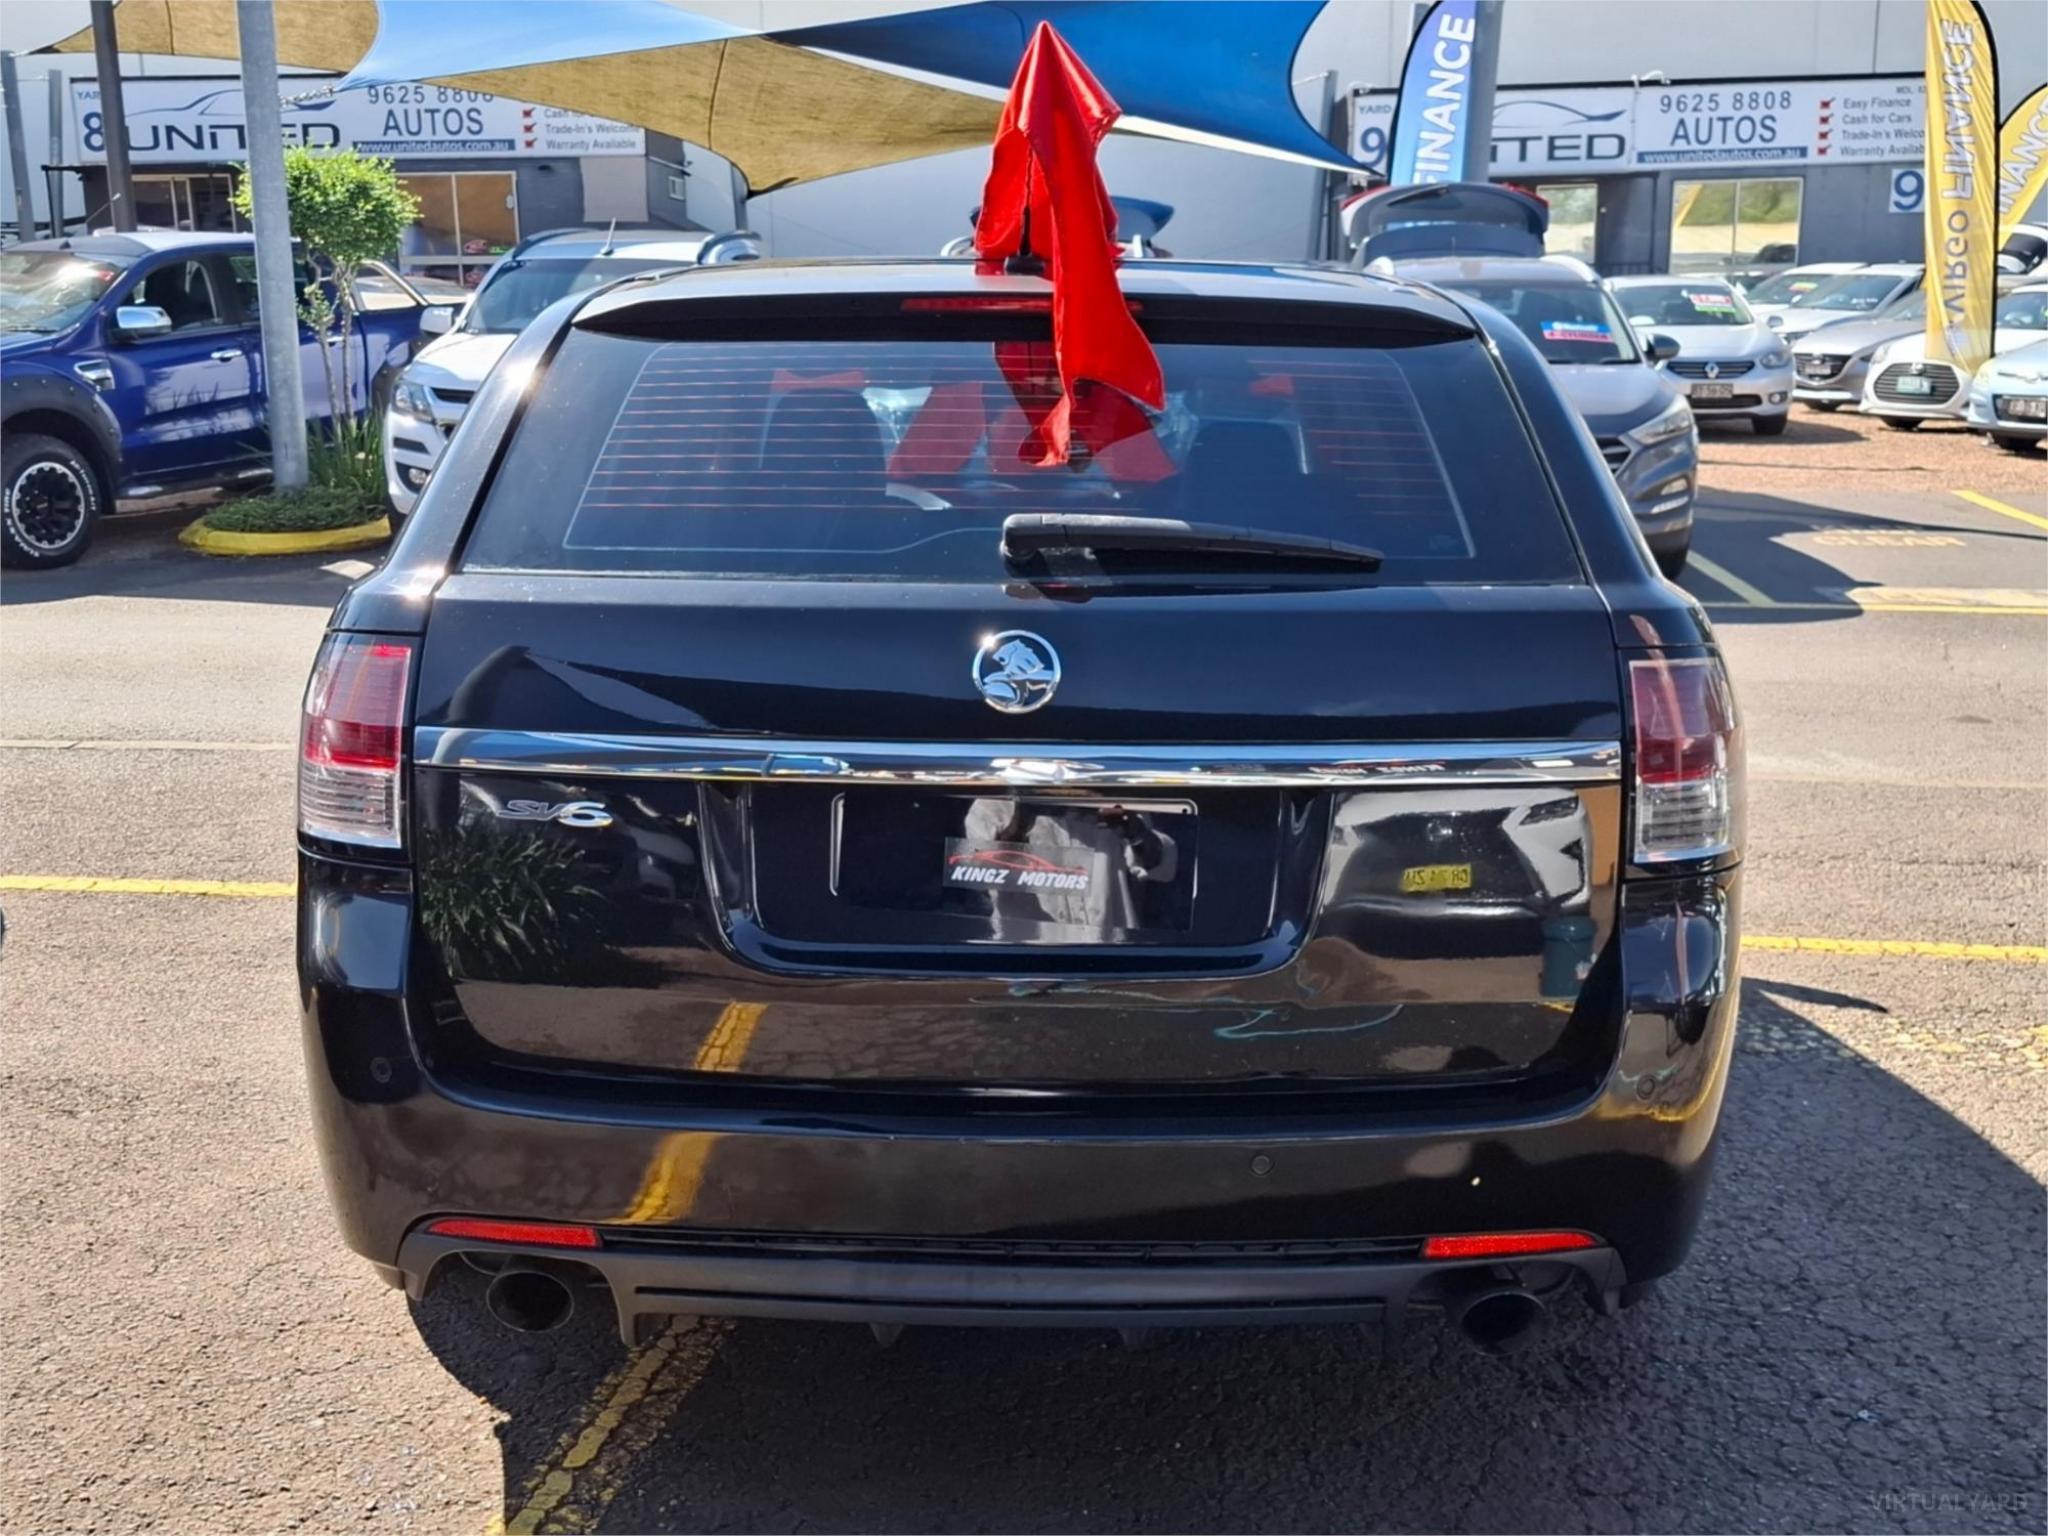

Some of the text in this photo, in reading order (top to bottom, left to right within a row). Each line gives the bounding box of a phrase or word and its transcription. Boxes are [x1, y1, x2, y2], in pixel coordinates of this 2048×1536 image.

[367, 85, 425, 104] 9625
[1660, 90, 1792, 113] 9625 8808
[1871, 97, 1911, 108] Finance
[382, 107, 484, 136] AUTOS
[1359, 104, 1392, 114] YARD
[1842, 113, 1868, 124] Cash
[1888, 112, 1912, 124] Cars
[83, 111, 105, 152] 8
[1670, 114, 1777, 146] AUTOS
[1894, 128, 1925, 138] Welco
[1360, 127, 1387, 167] 9
[1894, 170, 1925, 211] 9
[498, 799, 614, 828] SV6
[951, 865, 1089, 890] KINGZ MOTORS
